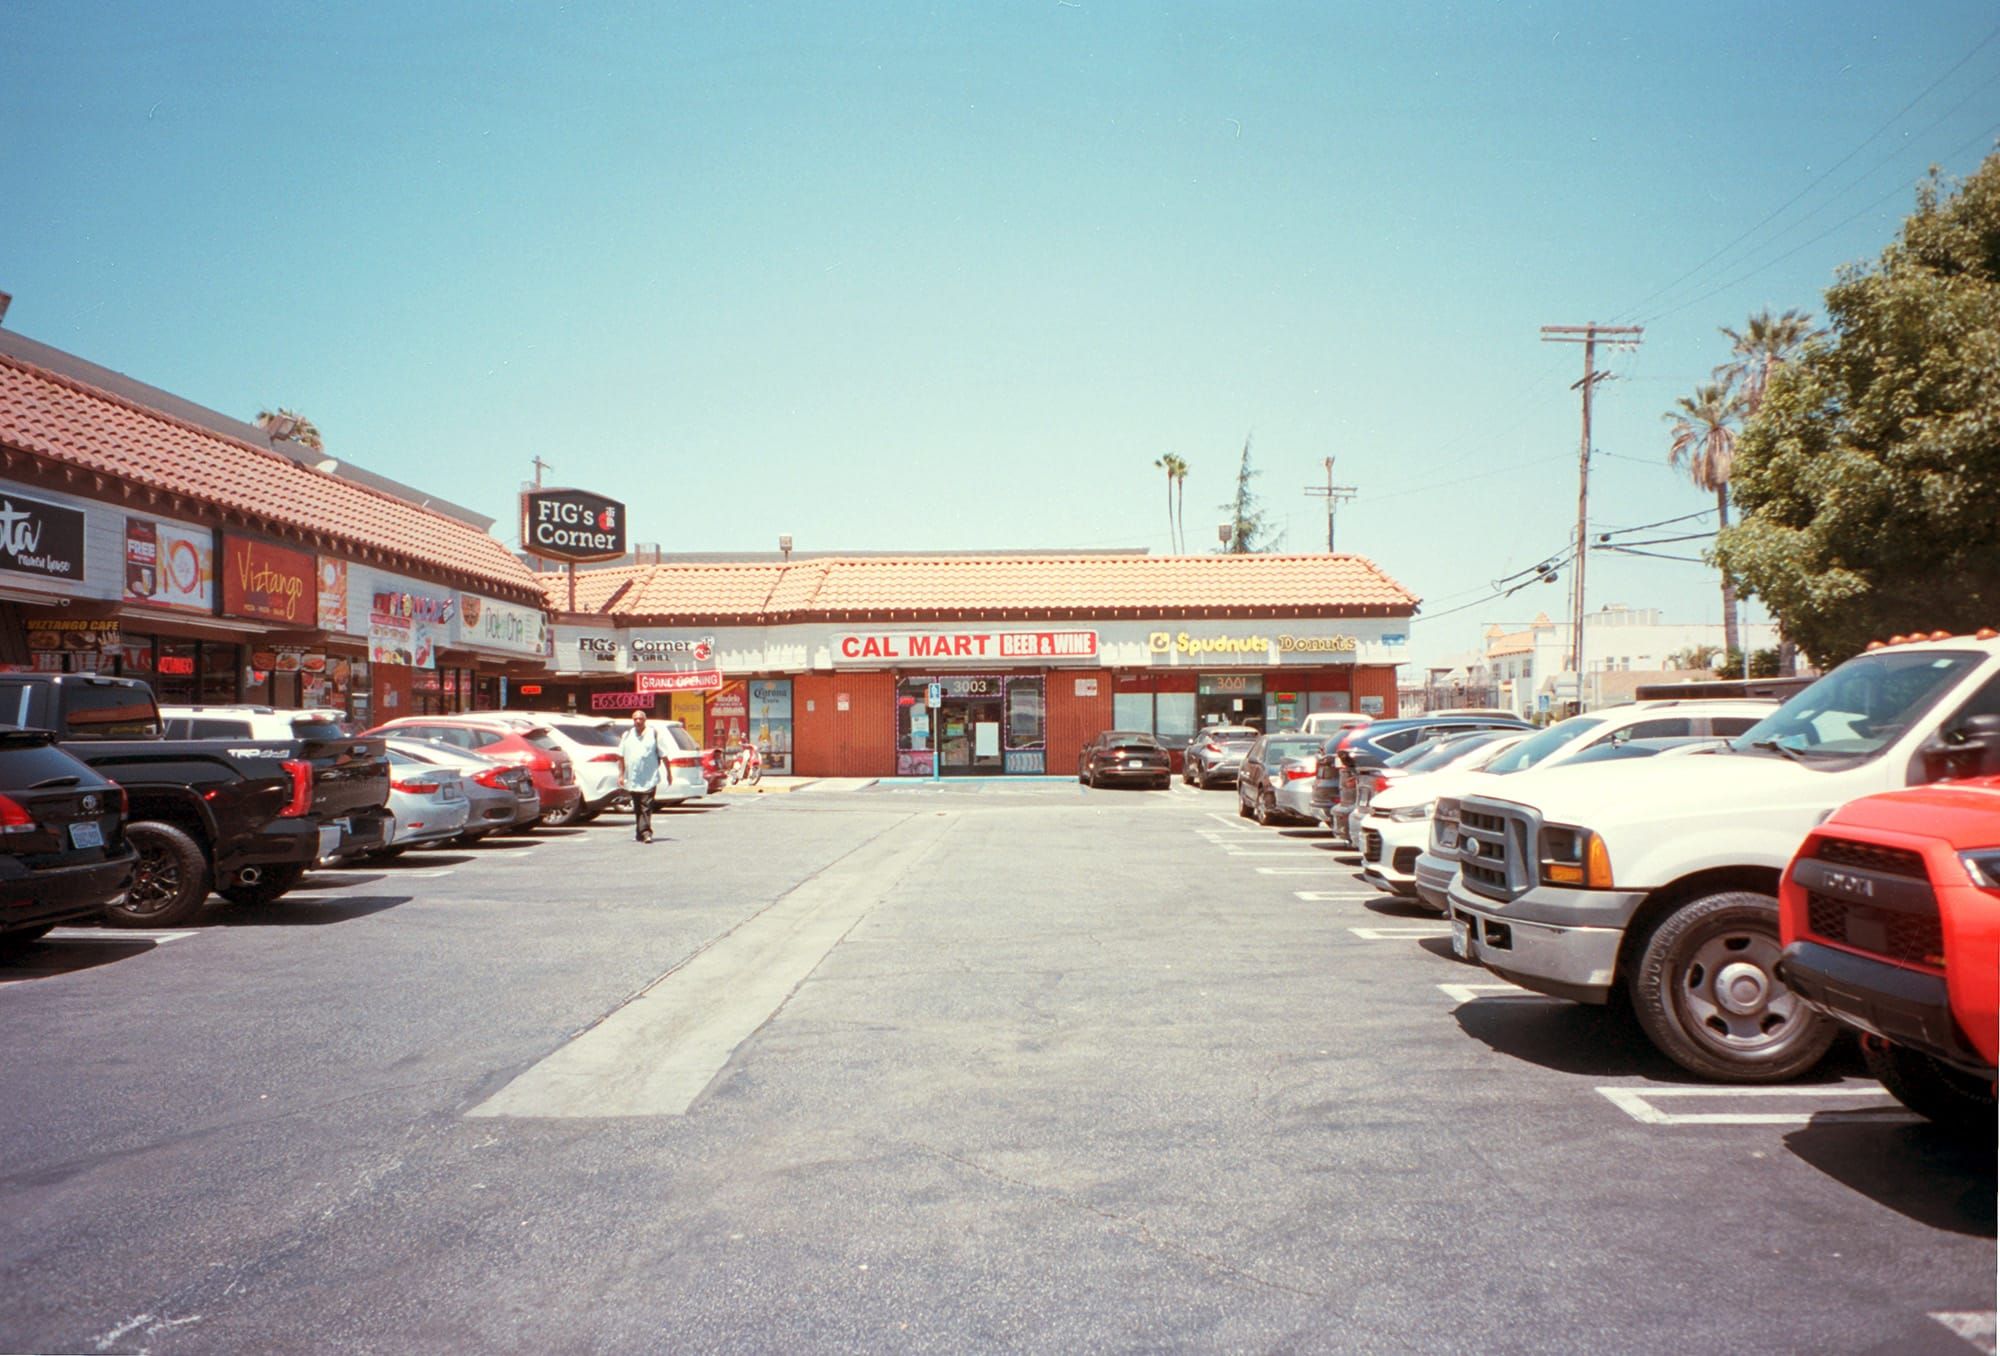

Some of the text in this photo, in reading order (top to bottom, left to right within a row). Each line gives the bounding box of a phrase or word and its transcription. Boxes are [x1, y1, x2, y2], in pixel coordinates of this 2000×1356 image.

[538, 500, 594, 525] FIG's
[0, 500, 41, 556] ta
[537, 523, 617, 549] Corner
[237, 541, 303, 620] Viztango
[27, 620, 119, 631] VIZTANGO CAFE
[579, 637, 690, 651] FIG's Corner
[842, 635, 990, 657] CAL MART
[1003, 633, 1092, 655] BEER & WINE
[1176, 634, 1357, 656] Spudnuts Donuts
[641, 675, 718, 688] GRAND OPENING
[953, 681, 987, 693] 3003
[1217, 677, 1246, 690] 3001
